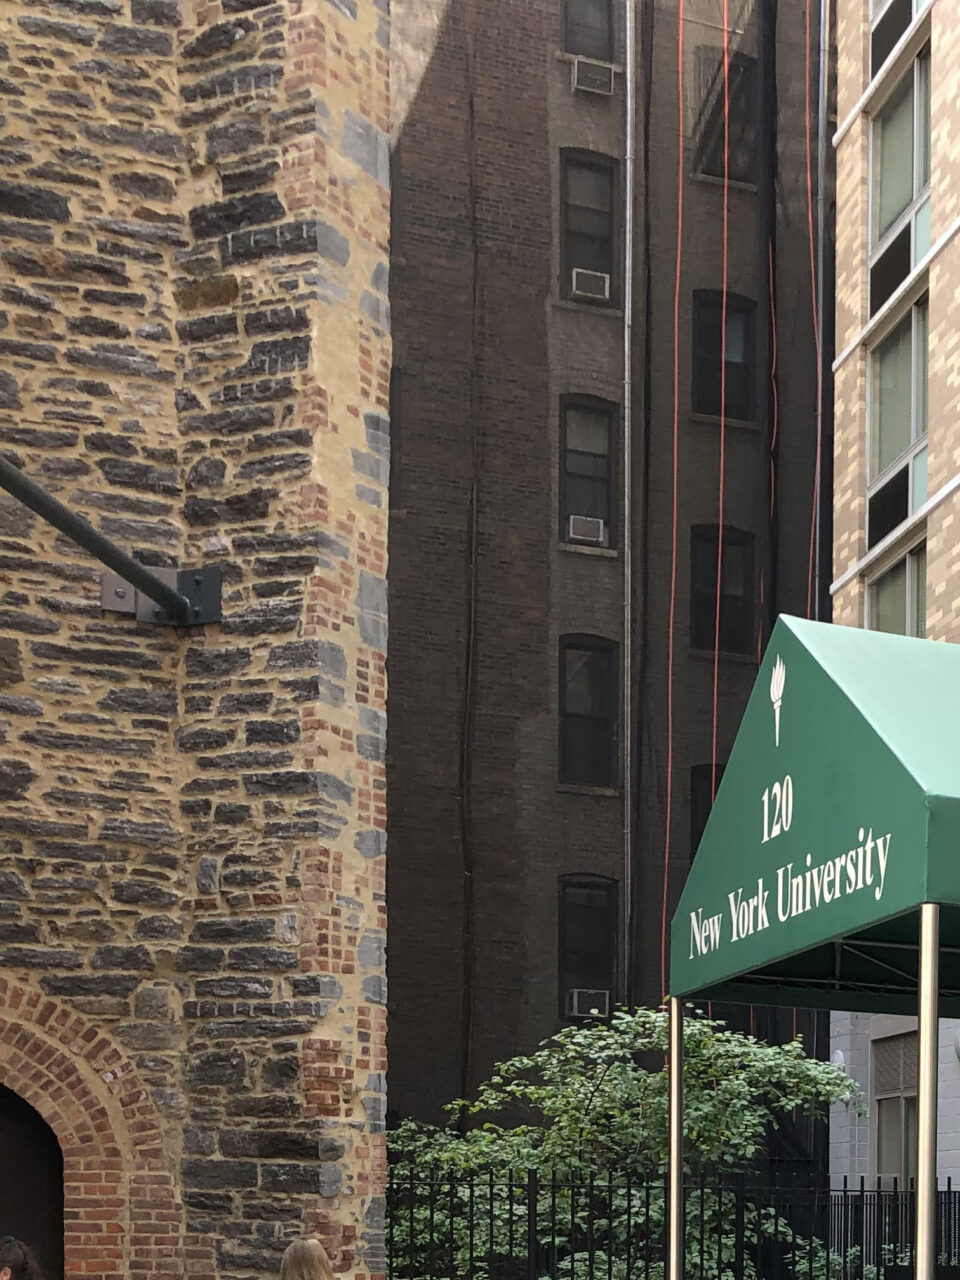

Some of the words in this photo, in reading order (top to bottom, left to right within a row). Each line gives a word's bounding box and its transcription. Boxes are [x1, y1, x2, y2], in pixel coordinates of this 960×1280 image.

[761, 775, 793, 844] 120
[689, 907, 723, 960] New
[728, 878, 770, 943] York
[776, 827, 892, 922] University
